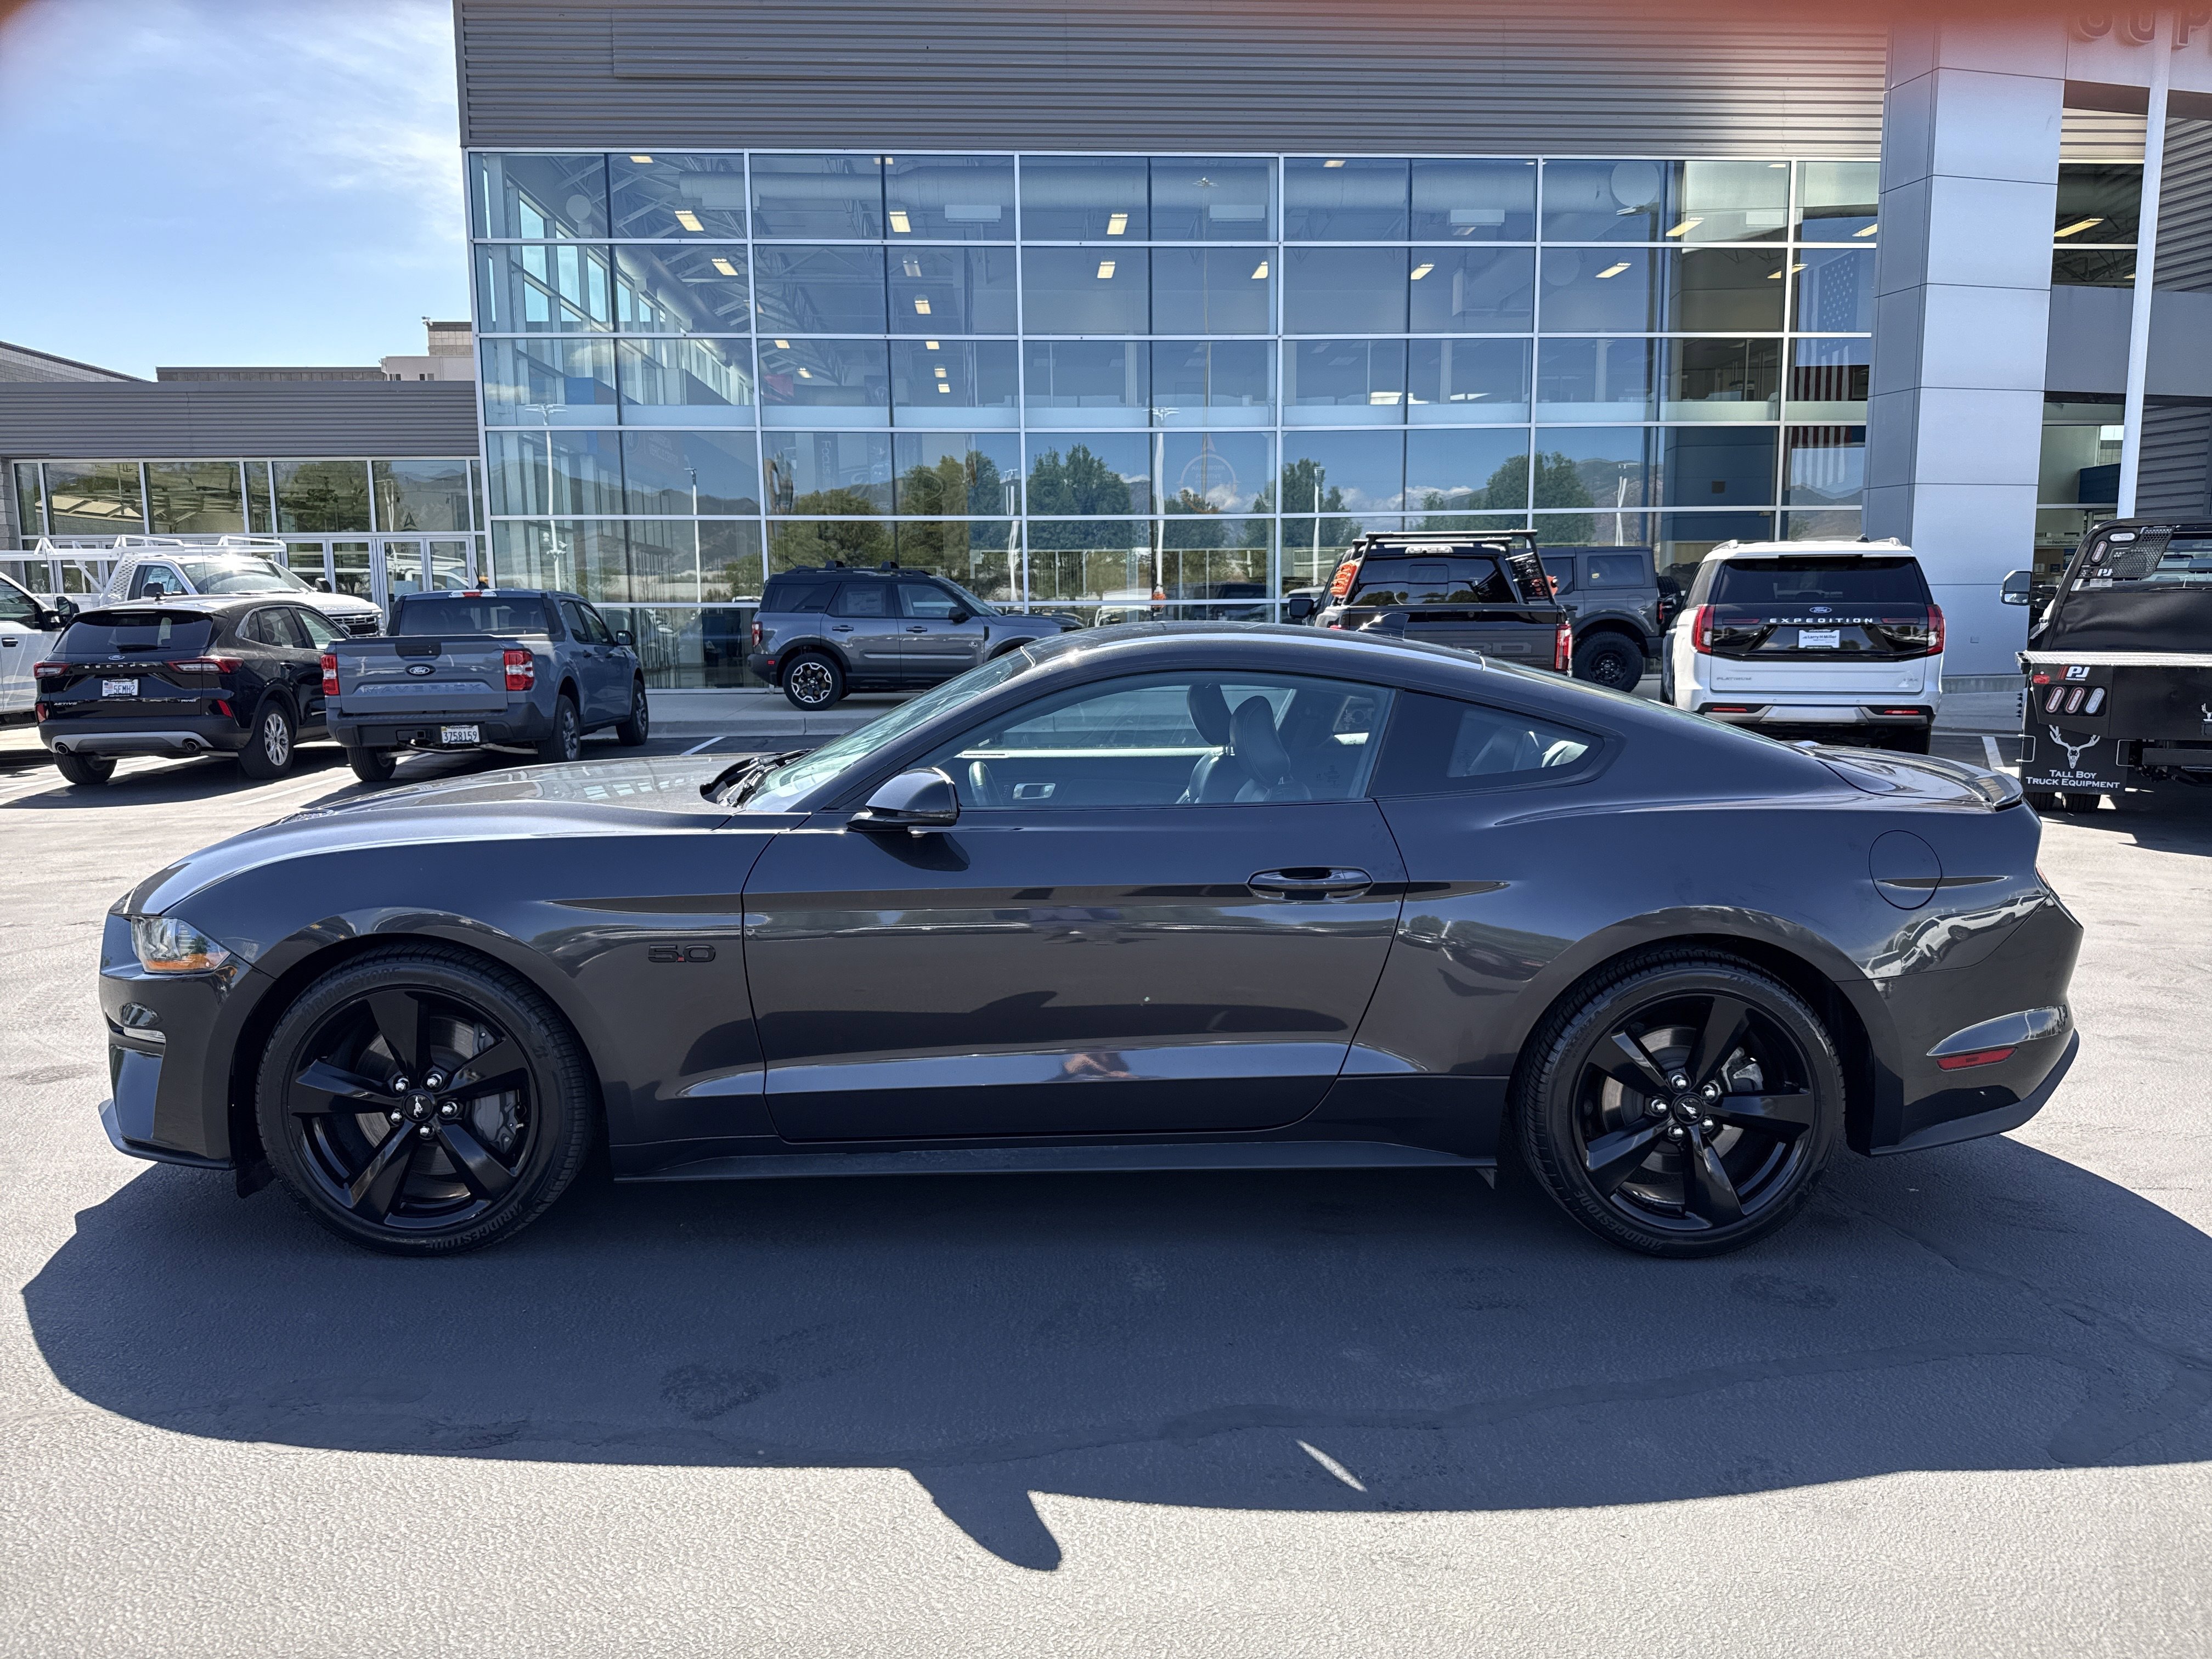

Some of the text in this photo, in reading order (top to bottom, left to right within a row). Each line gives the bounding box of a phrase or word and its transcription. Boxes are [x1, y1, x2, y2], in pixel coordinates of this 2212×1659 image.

[2066, 666, 2090, 678] PJ
[363, 684, 481, 693] MAVERICK
[443, 731, 477, 741] 3758159
[2049, 769, 2097, 779] TALL BOY
[2025, 776, 2120, 789] TRUCK EQUIPMENT
[647, 944, 716, 963] 5.0
[425, 1200, 523, 1251] BRIDGESTONE
[1573, 1188, 1664, 1251] BRIDGESTONE
